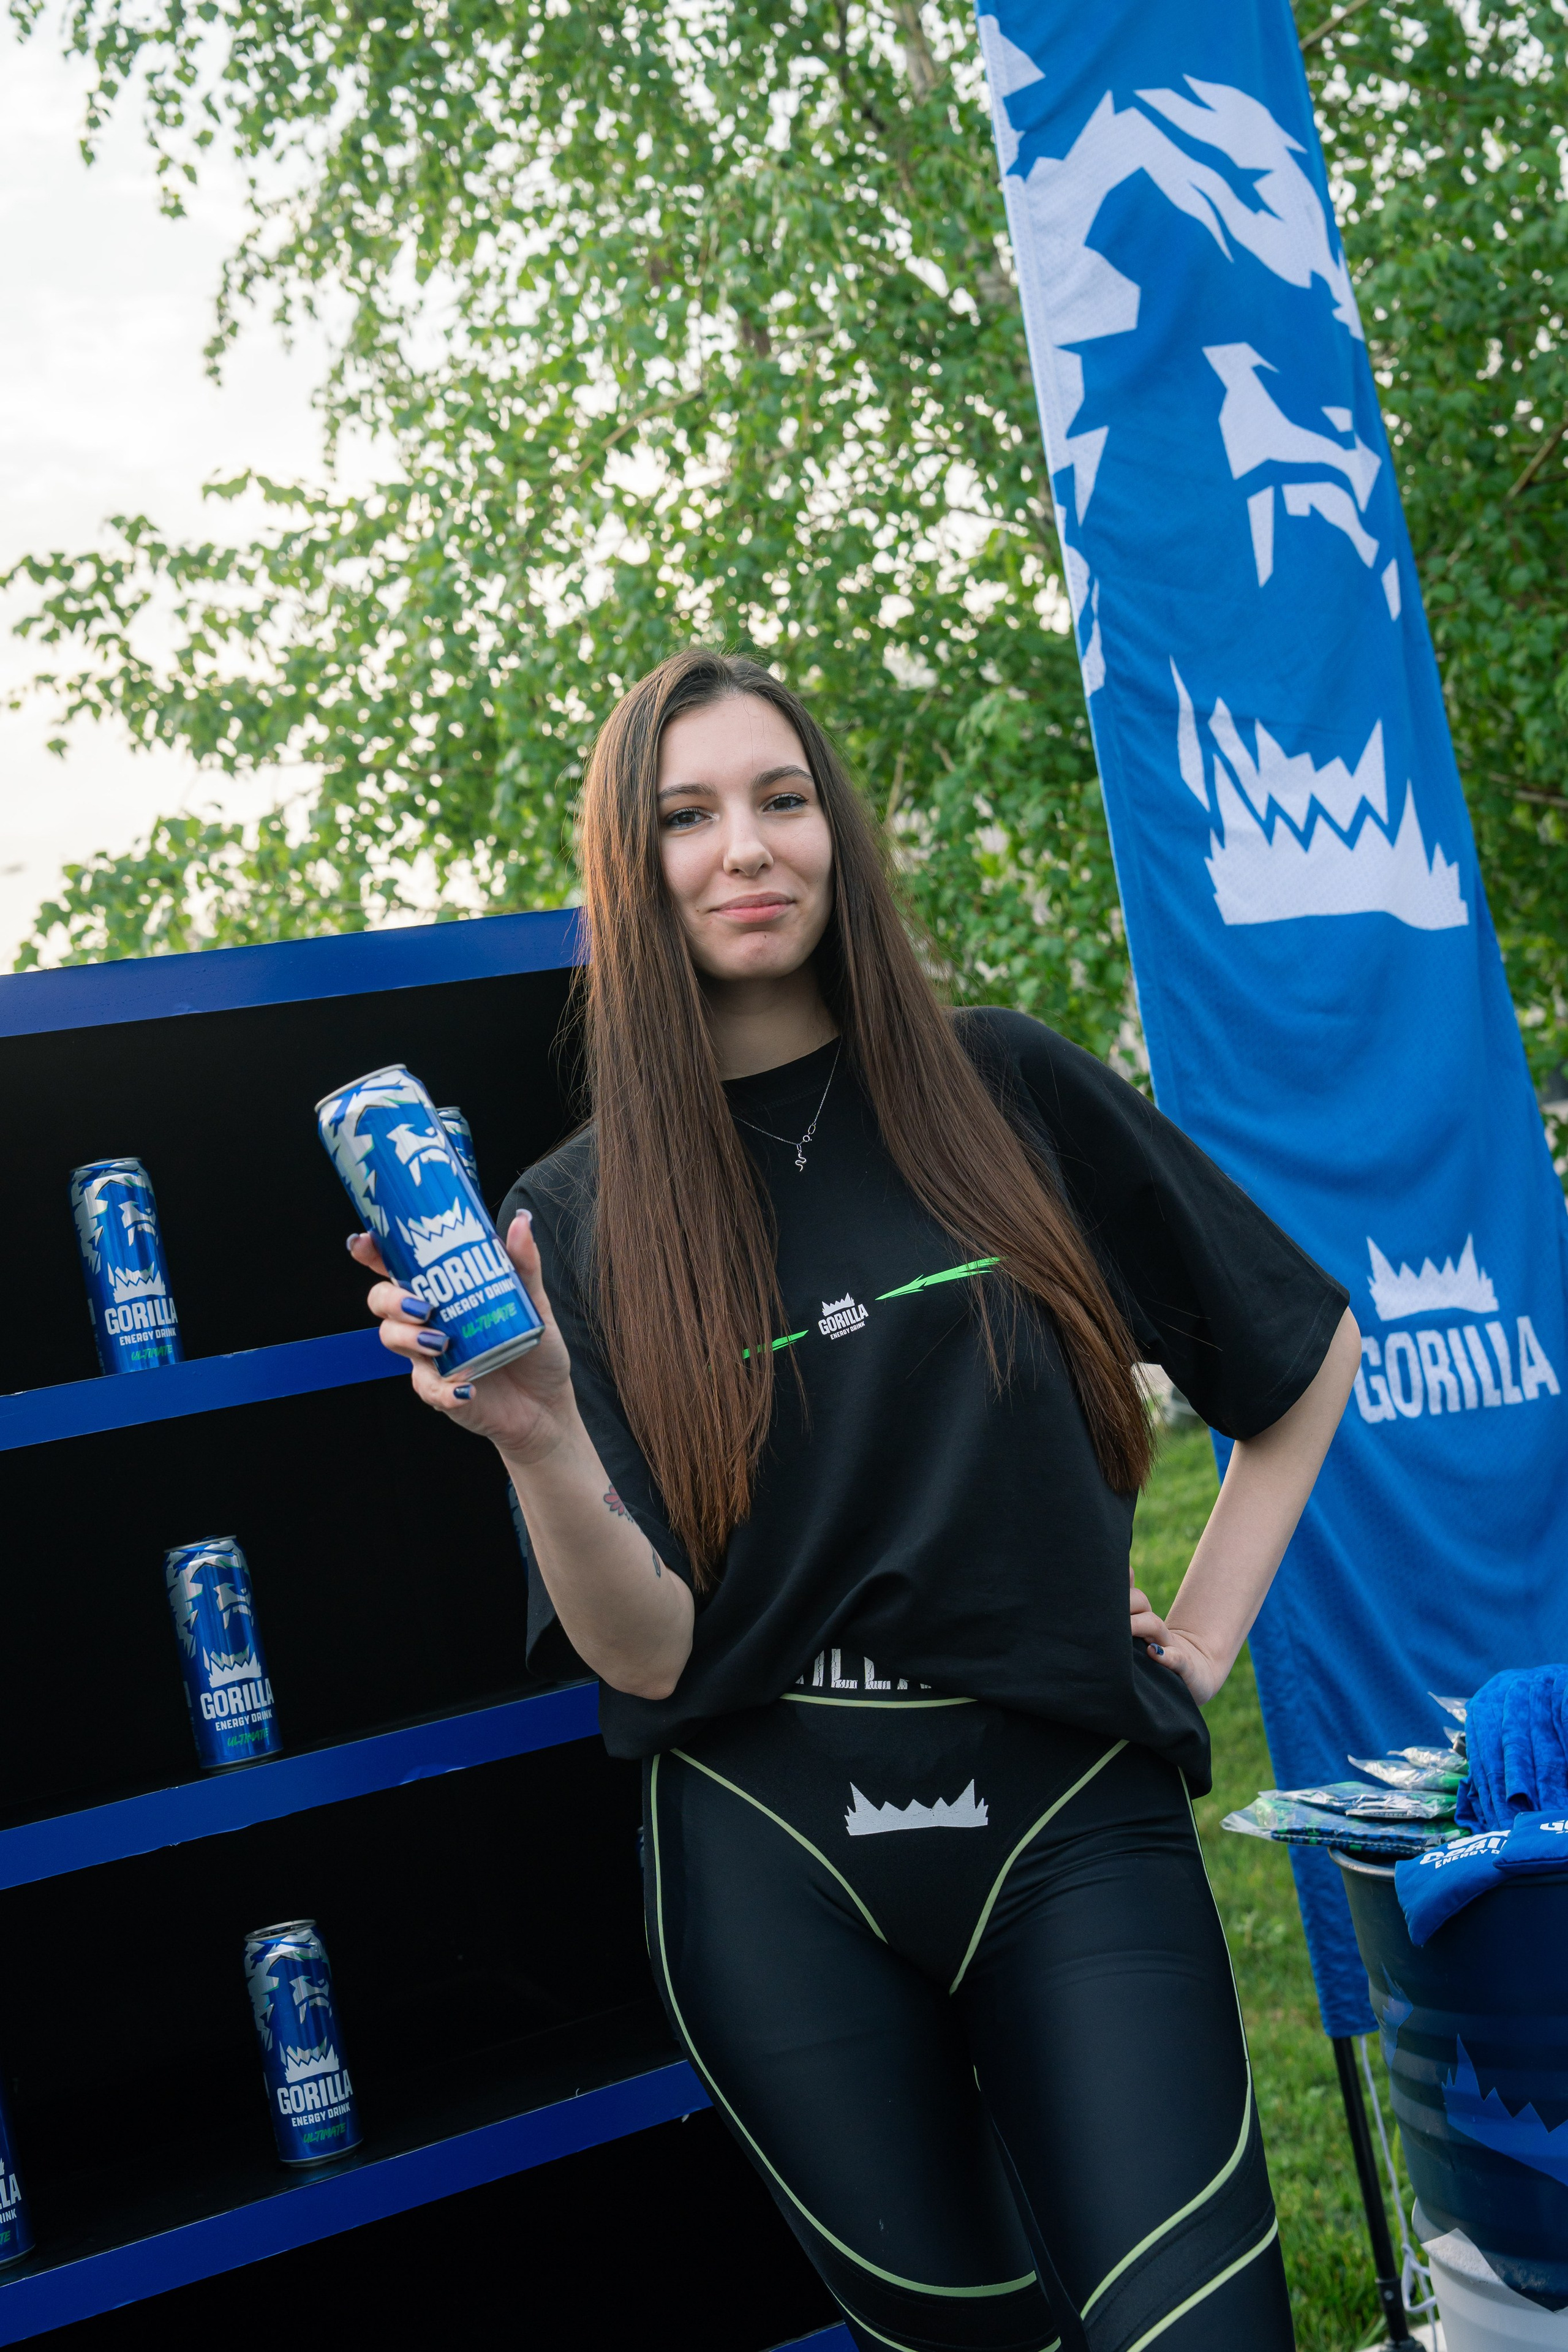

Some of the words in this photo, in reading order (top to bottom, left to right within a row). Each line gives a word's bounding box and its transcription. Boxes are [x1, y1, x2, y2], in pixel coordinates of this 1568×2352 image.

[411, 1238, 515, 1308] GORILLA
[105, 1297, 178, 1335] GORILLA
[439, 1290, 485, 1323] ENERGY
[484, 1278, 516, 1300] DRINK
[462, 1302, 517, 1338] ULTIMATE
[818, 1303, 869, 1335] GORILLA
[830, 1327, 850, 1340] ENERGY
[850, 1321, 865, 1332] DRINK
[119, 1330, 154, 1346] ENERGY
[155, 1327, 176, 1339] DRINK
[131, 1344, 173, 1361] ULTIMATE
[1354, 1316, 1561, 1424] GORILLA
[200, 1678, 274, 1721] GORILLA
[215, 1715, 250, 1732] ENERGY
[251, 1709, 273, 1723] DRINK
[227, 1727, 269, 1747] ULTIMATE
[277, 2069, 353, 2115] GORILLA
[291, 2111, 326, 2127] ENERGY
[327, 2102, 351, 2119] DRINK
[303, 2122, 346, 2144] ULTIMATE
